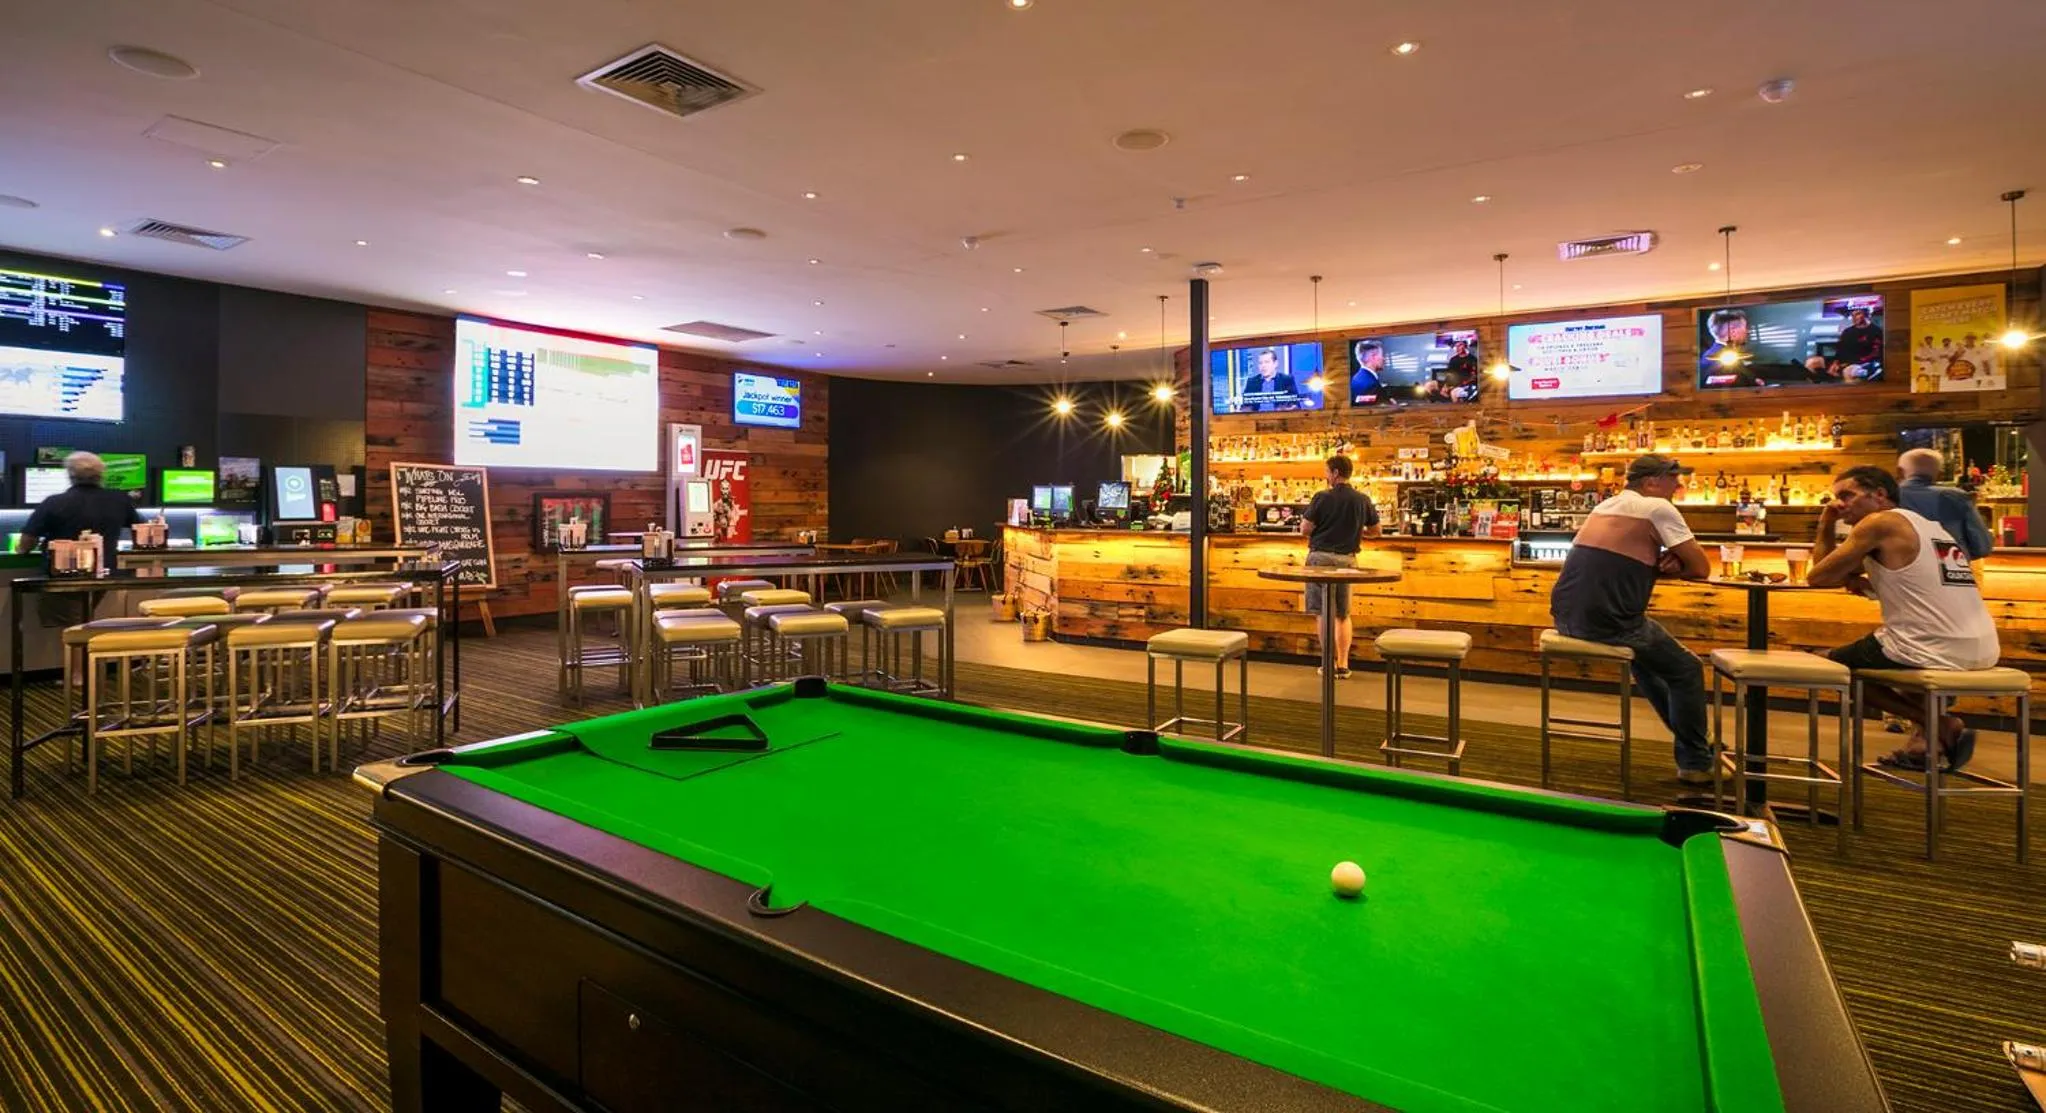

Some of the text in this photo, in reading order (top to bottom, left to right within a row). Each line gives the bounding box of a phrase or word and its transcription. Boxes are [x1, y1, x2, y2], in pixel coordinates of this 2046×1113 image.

[743, 391, 793, 403] Jackpot winner
[752, 403, 785, 416] $17,463
[704, 459, 747, 481] UFC
